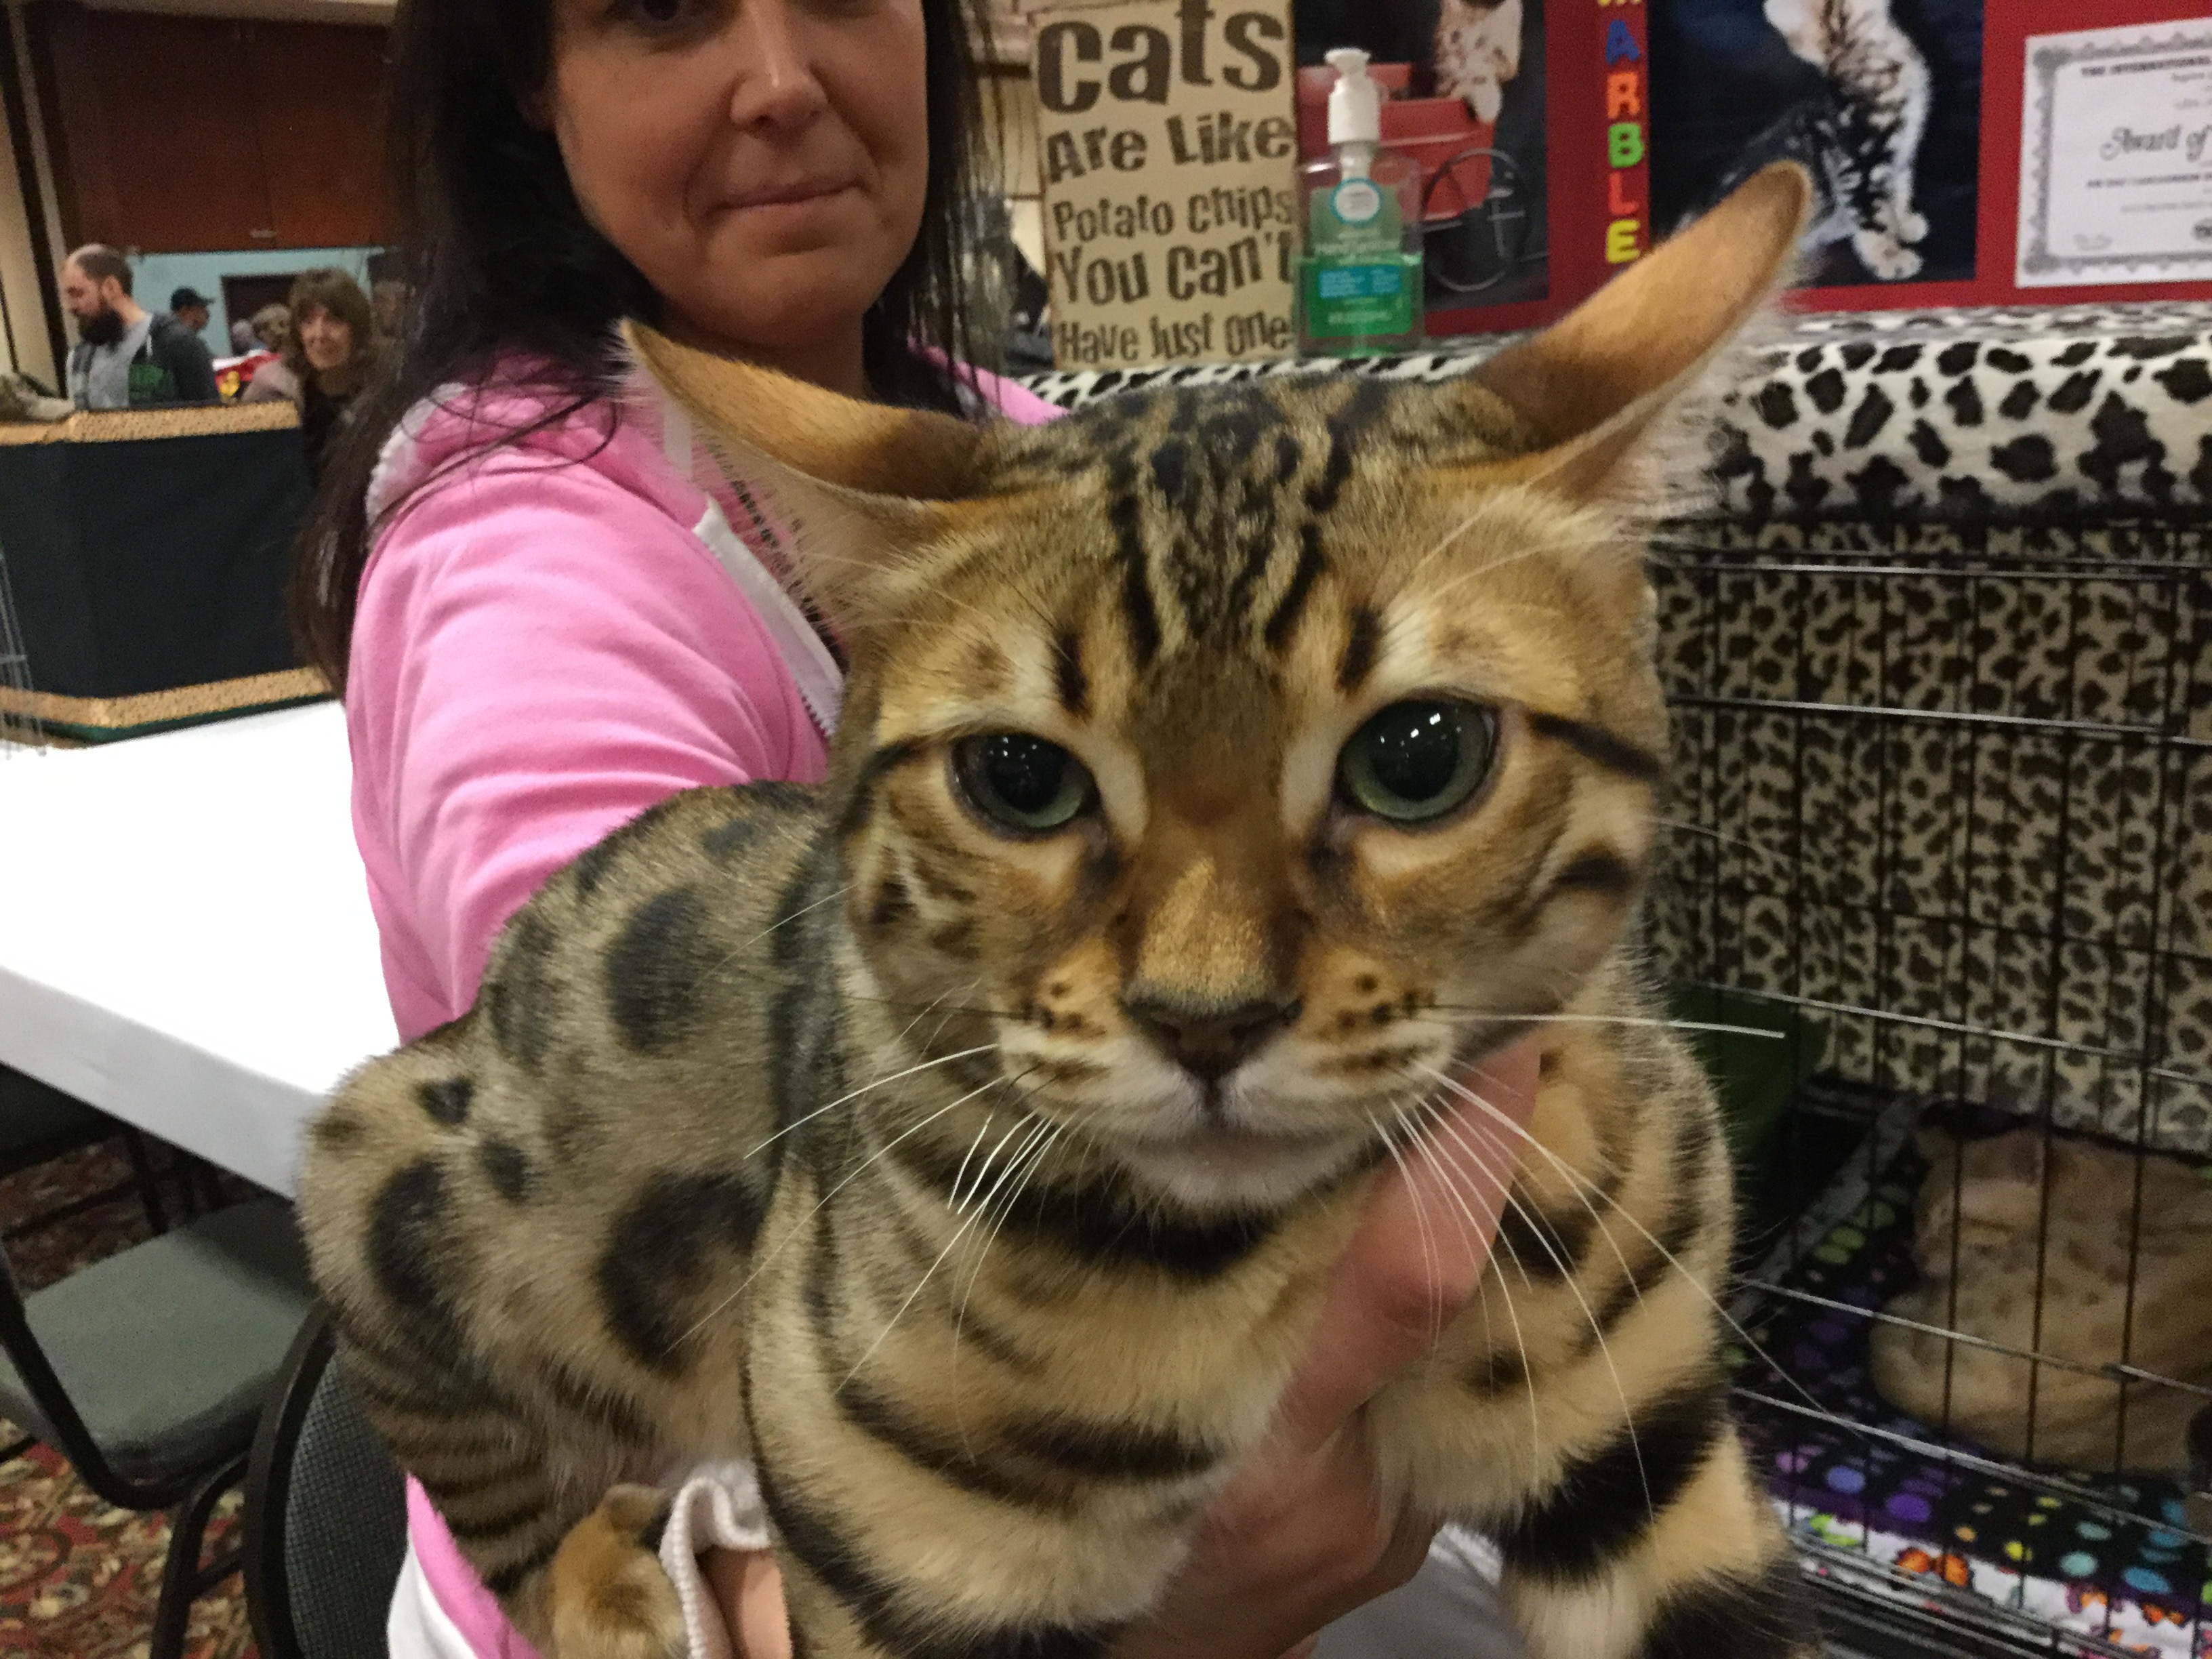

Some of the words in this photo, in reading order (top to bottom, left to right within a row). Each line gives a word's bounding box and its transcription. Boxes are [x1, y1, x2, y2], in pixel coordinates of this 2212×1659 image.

[1046, 124, 1148, 184] Are
[1165, 110, 1294, 166] Like
[1597, 0, 1645, 264] ARBLE
[1052, 194, 1176, 243] Potato
[1054, 244, 1151, 306] You
[1057, 321, 1142, 364] Have
